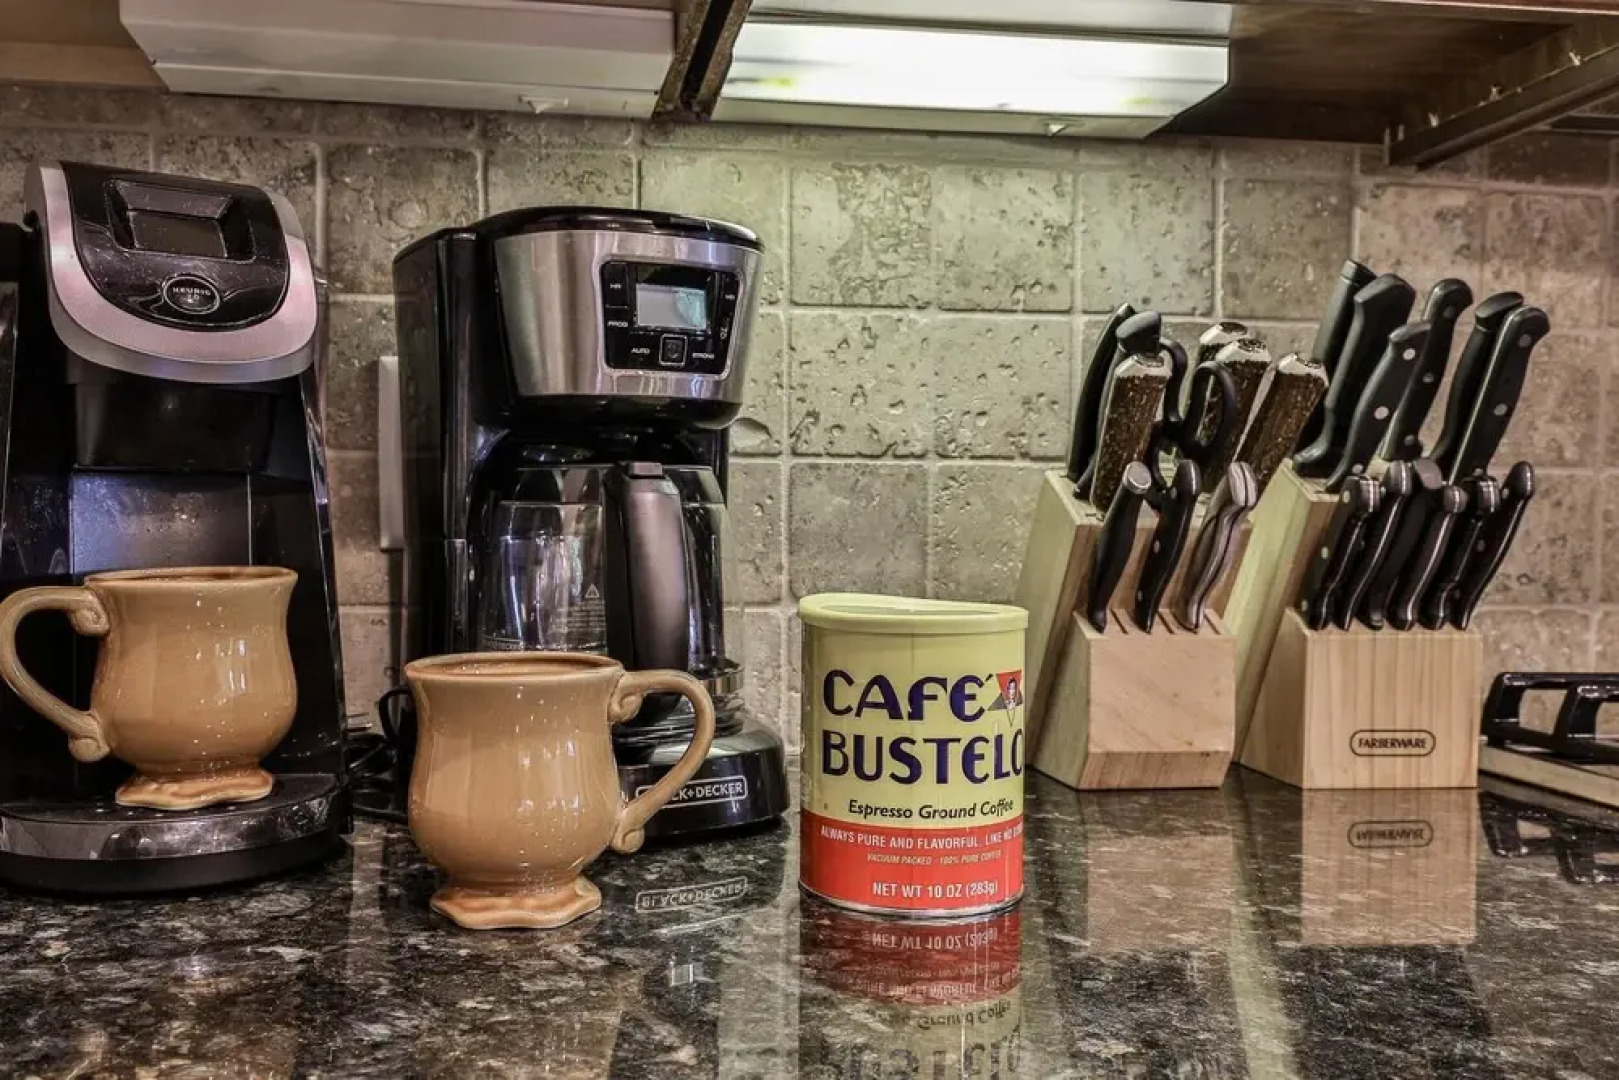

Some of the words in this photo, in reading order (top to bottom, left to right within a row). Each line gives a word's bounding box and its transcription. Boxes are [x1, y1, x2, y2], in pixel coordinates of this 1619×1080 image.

[172, 287, 211, 296] KEURIG
[631, 347, 651, 355] AUTO
[823, 669, 994, 722] CAFÉ
[1357, 737, 1427, 749] FARBERWARE
[848, 799, 913, 819] Espresso
[918, 800, 976, 819] Ground
[980, 798, 1014, 818] Coffee
[820, 825, 854, 843] ALWAYS
[857, 833, 887, 848] PURE
[889, 837, 914, 849] AND
[985, 831, 1003, 846] LIKE
[866, 852, 900, 864] VACUUM
[901, 855, 932, 866] PACKED
[940, 855, 960, 865] 100%
[872, 882, 898, 897] NET
[901, 885, 922, 898] WT
[927, 885, 942, 898] 10
[946, 883, 962, 898] OZ
[965, 880, 999, 897] (283g)
